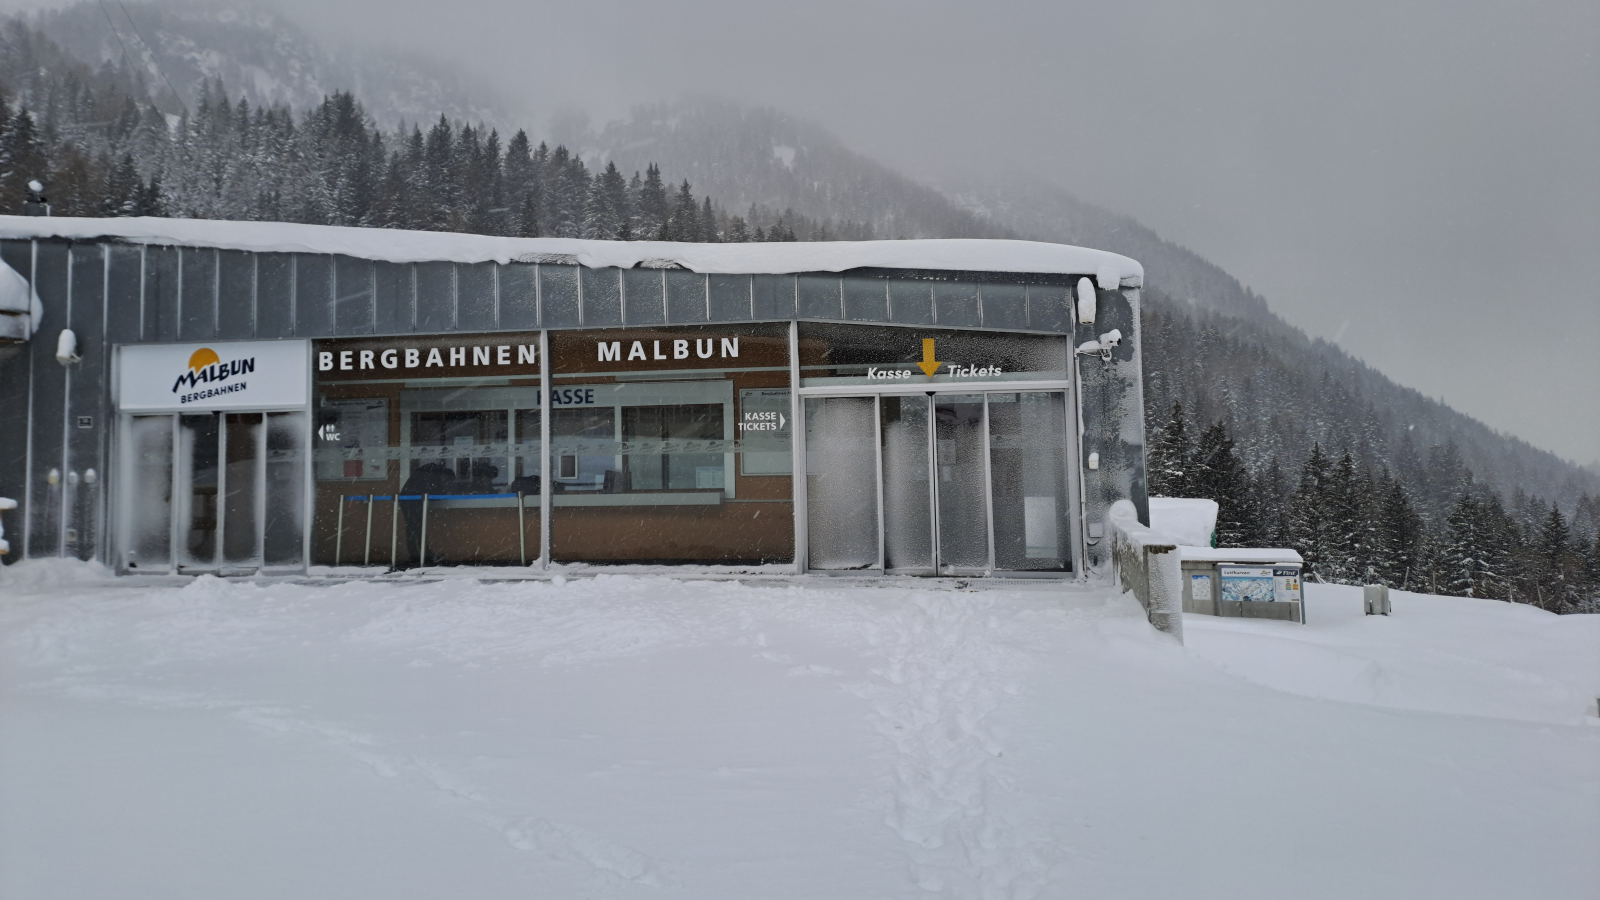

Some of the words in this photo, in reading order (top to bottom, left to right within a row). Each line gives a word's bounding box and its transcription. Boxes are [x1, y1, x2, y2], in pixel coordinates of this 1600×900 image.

[319, 344, 535, 371] BERGBAHNEN
[597, 337, 739, 362] MALBUN
[172, 357, 255, 393] MALBUN
[867, 367, 912, 380] Kasse
[947, 364, 1002, 378] Tickets
[181, 382, 247, 404] BERGBAHNEN
[745, 412, 777, 420] KASSE
[738, 422, 777, 431] TICKETS
[325, 433, 341, 441] WC
